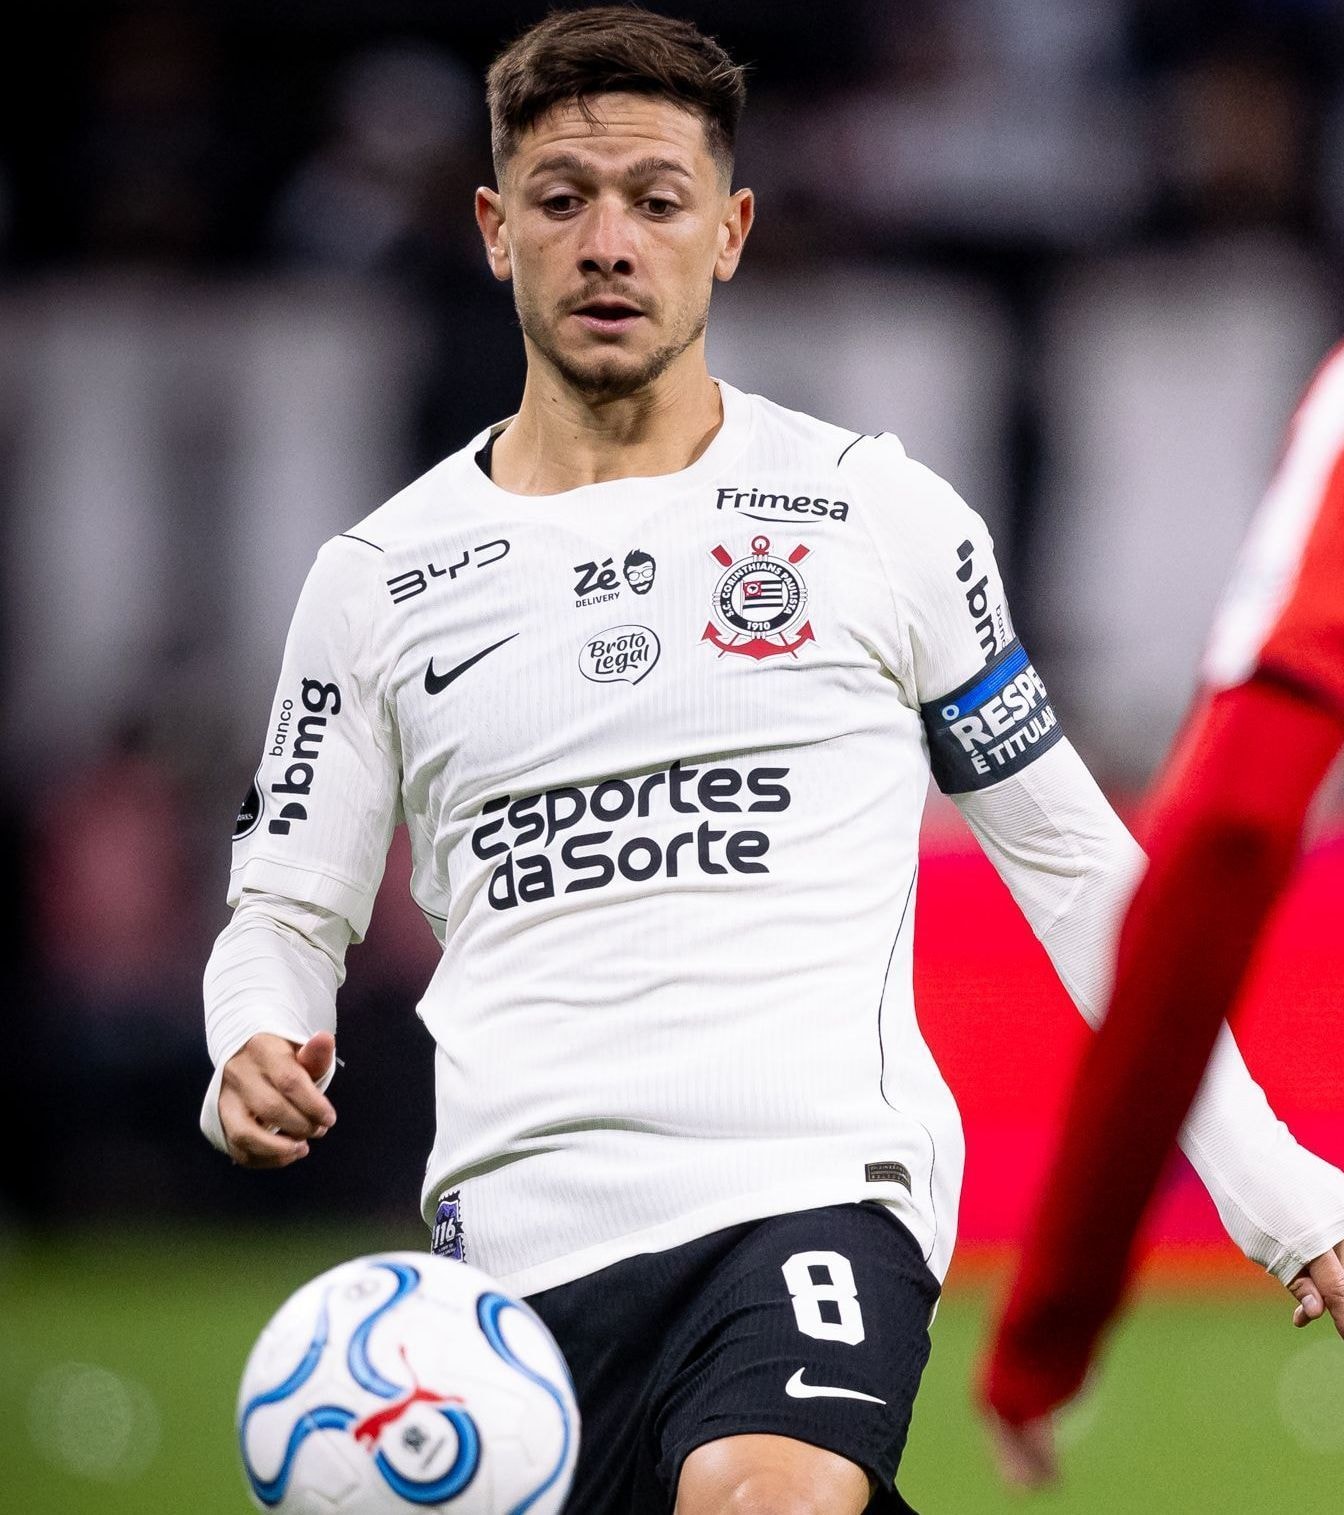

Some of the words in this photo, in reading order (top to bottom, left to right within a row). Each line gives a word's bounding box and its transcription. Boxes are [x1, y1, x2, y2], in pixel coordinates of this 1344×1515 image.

[716, 487, 849, 522] Frimesa
[386, 539, 511, 605] BYD
[573, 557, 621, 597] Zé
[721, 562, 783, 599] CORINTHIANS
[780, 571, 799, 615] PAULISTA
[575, 591, 621, 608] DELIVERY
[746, 621, 771, 631] 1910
[965, 574, 997, 664] bm
[587, 632, 646, 659] Broto
[595, 644, 650, 675] Legal
[269, 699, 293, 757] banco
[949, 665, 1048, 753] RESPE
[271, 677, 341, 796] bmg
[971, 749, 991, 775] É
[471, 759, 791, 861] Esportes
[781, 1250, 864, 1346] 8
